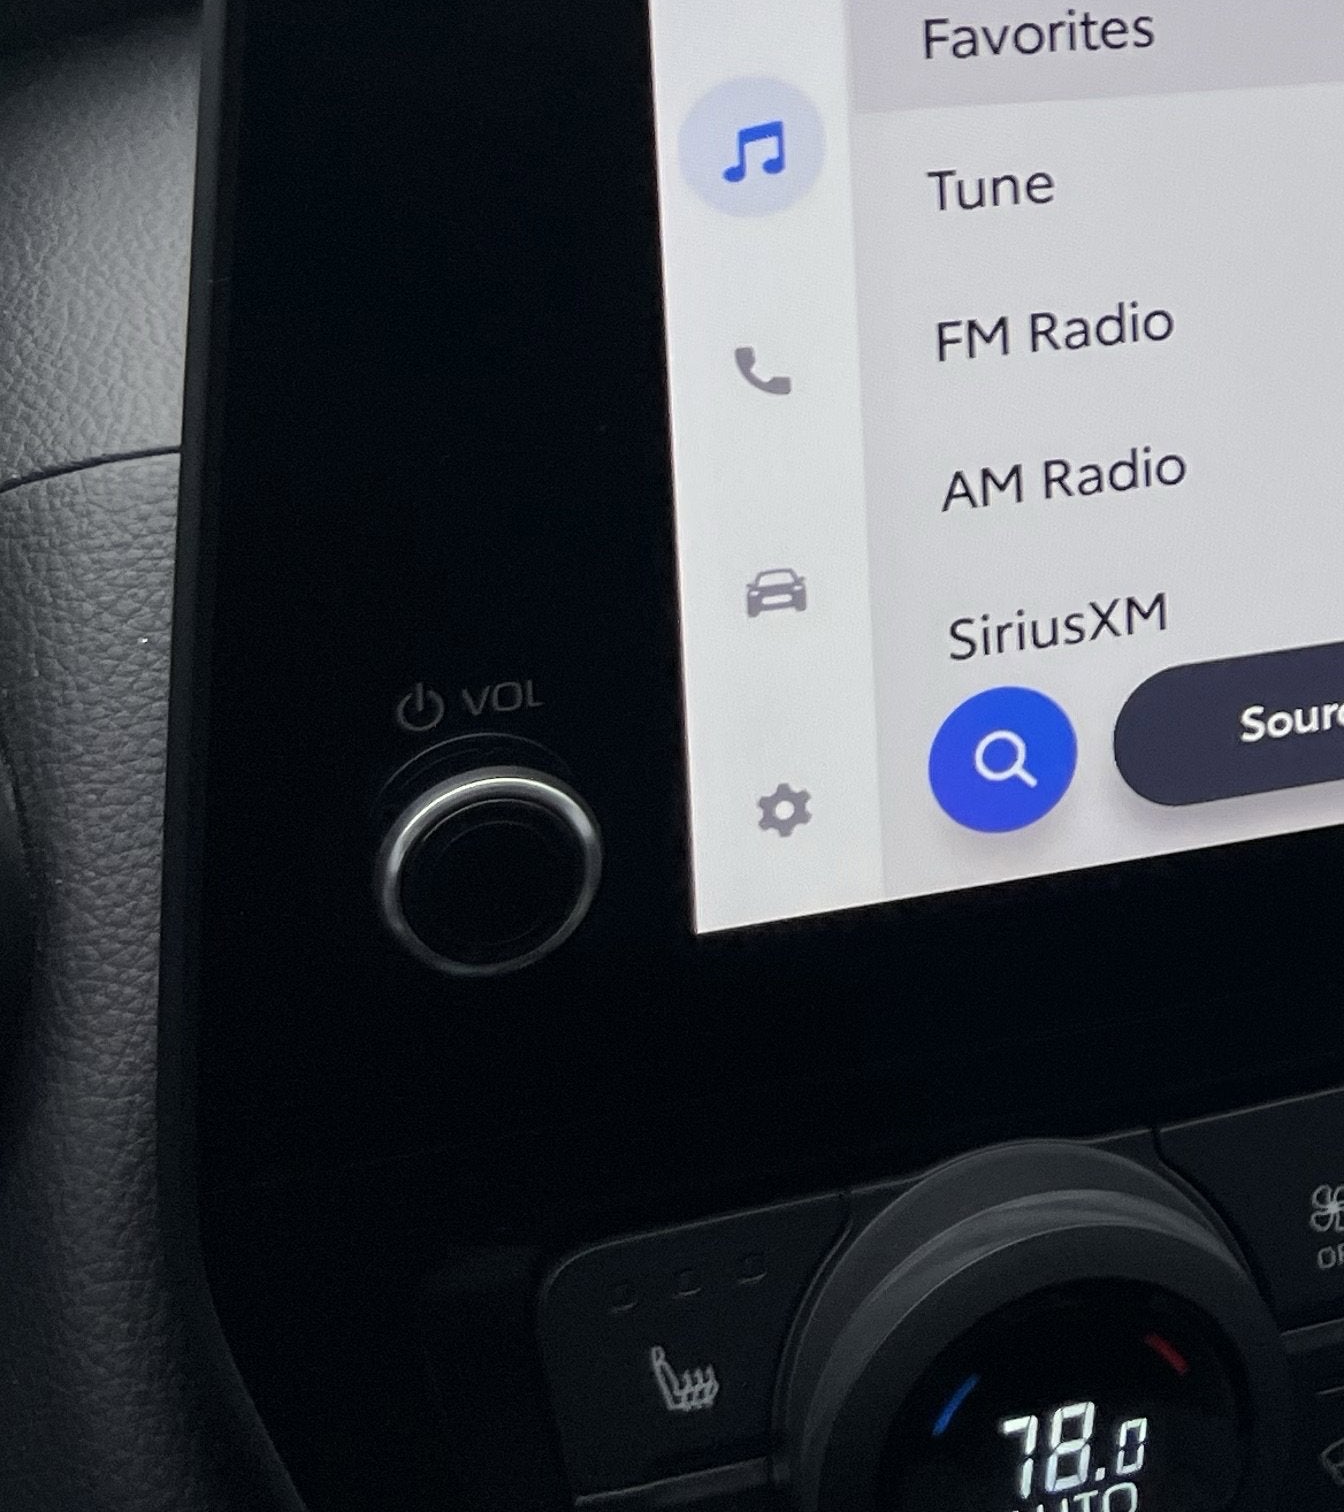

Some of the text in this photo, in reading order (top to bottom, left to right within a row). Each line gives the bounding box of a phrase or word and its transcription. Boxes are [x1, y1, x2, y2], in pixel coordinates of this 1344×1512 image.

[922, 8, 1155, 60] Favorites
[925, 168, 1055, 211] Tune
[936, 301, 1175, 362] FM Radio
[941, 446, 1187, 513] AM Radio
[949, 592, 1169, 660] SiriusXM
[461, 679, 544, 716] VOL
[1002, 1401, 1148, 1499] 78.0
